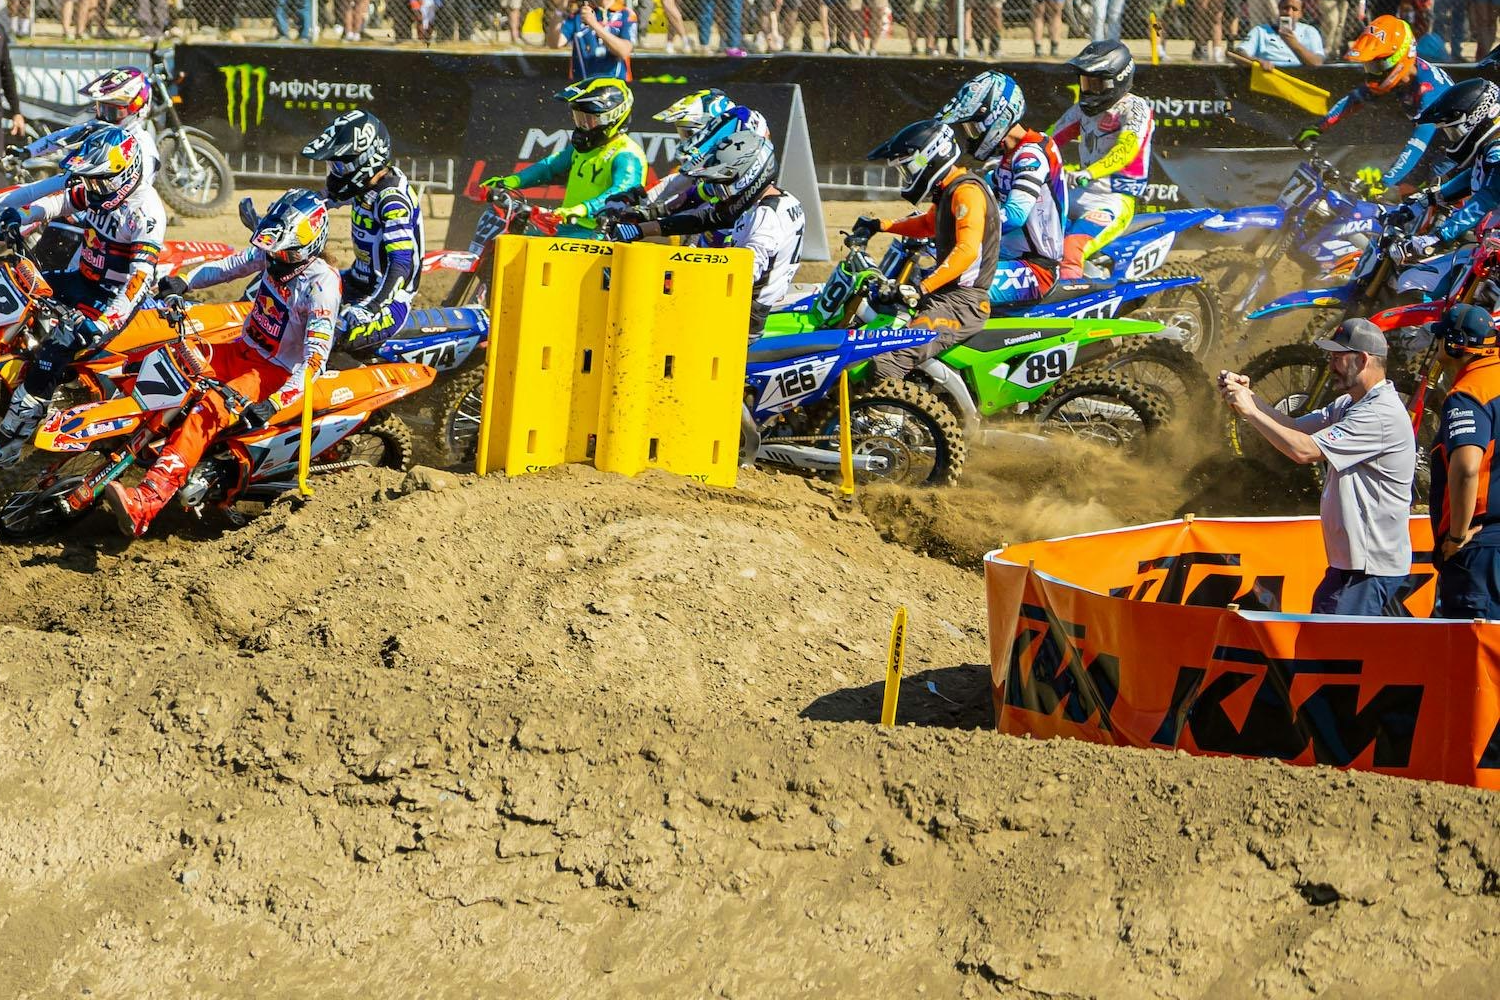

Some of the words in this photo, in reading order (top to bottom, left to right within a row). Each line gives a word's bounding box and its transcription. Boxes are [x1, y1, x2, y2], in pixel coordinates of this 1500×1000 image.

[269, 79, 374, 100] MONSTER
[284, 101, 359, 111] ENERGY
[1148, 96, 1226, 117] ONSTER
[1335, 218, 1374, 237] MXA
[669, 252, 729, 265] ACERBIS
[1132, 247, 1161, 277] 517
[1004, 331, 1042, 346] Kawasaki
[411, 342, 456, 371] 174
[1025, 349, 1067, 384] 89
[135, 360, 184, 396] 7
[775, 364, 816, 399] 126
[1005, 603, 1120, 732] KTM
[1151, 645, 1425, 770] KTM
